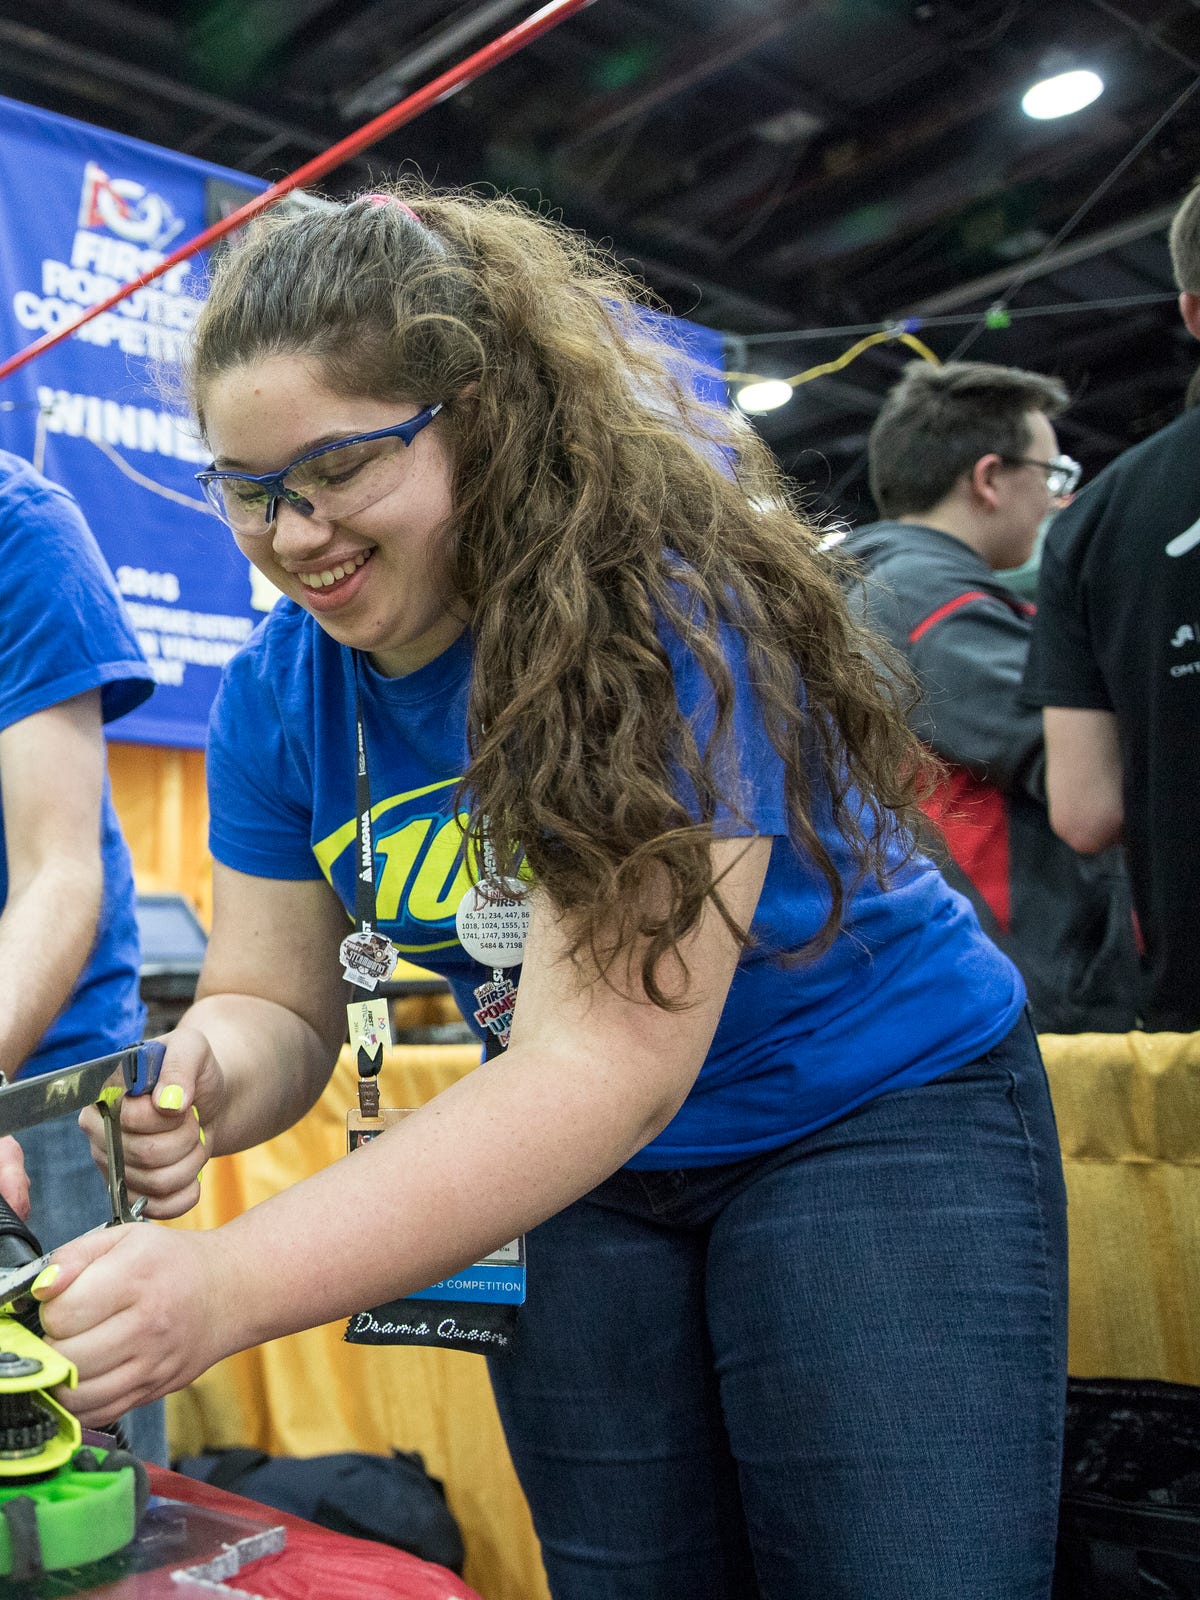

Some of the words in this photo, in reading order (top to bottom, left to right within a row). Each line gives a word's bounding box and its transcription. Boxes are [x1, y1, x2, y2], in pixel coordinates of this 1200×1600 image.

[42, 258, 202, 332] ROBOTIC
[37, 385, 215, 464] WINNE
[361, 810, 373, 867] MAGNA
[372, 811, 484, 922] 10
[481, 922, 500, 930] 1024,
[482, 932, 500, 940] 1747,
[506, 941, 523, 949] 7198
[476, 991, 517, 1025] POWE
[480, 981, 511, 1007] FIRST
[490, 1012, 513, 1033] UP
[447, 1279, 521, 1291] COMPETITION
[354, 1312, 431, 1336] Drama
[437, 1318, 506, 1345] Queen
